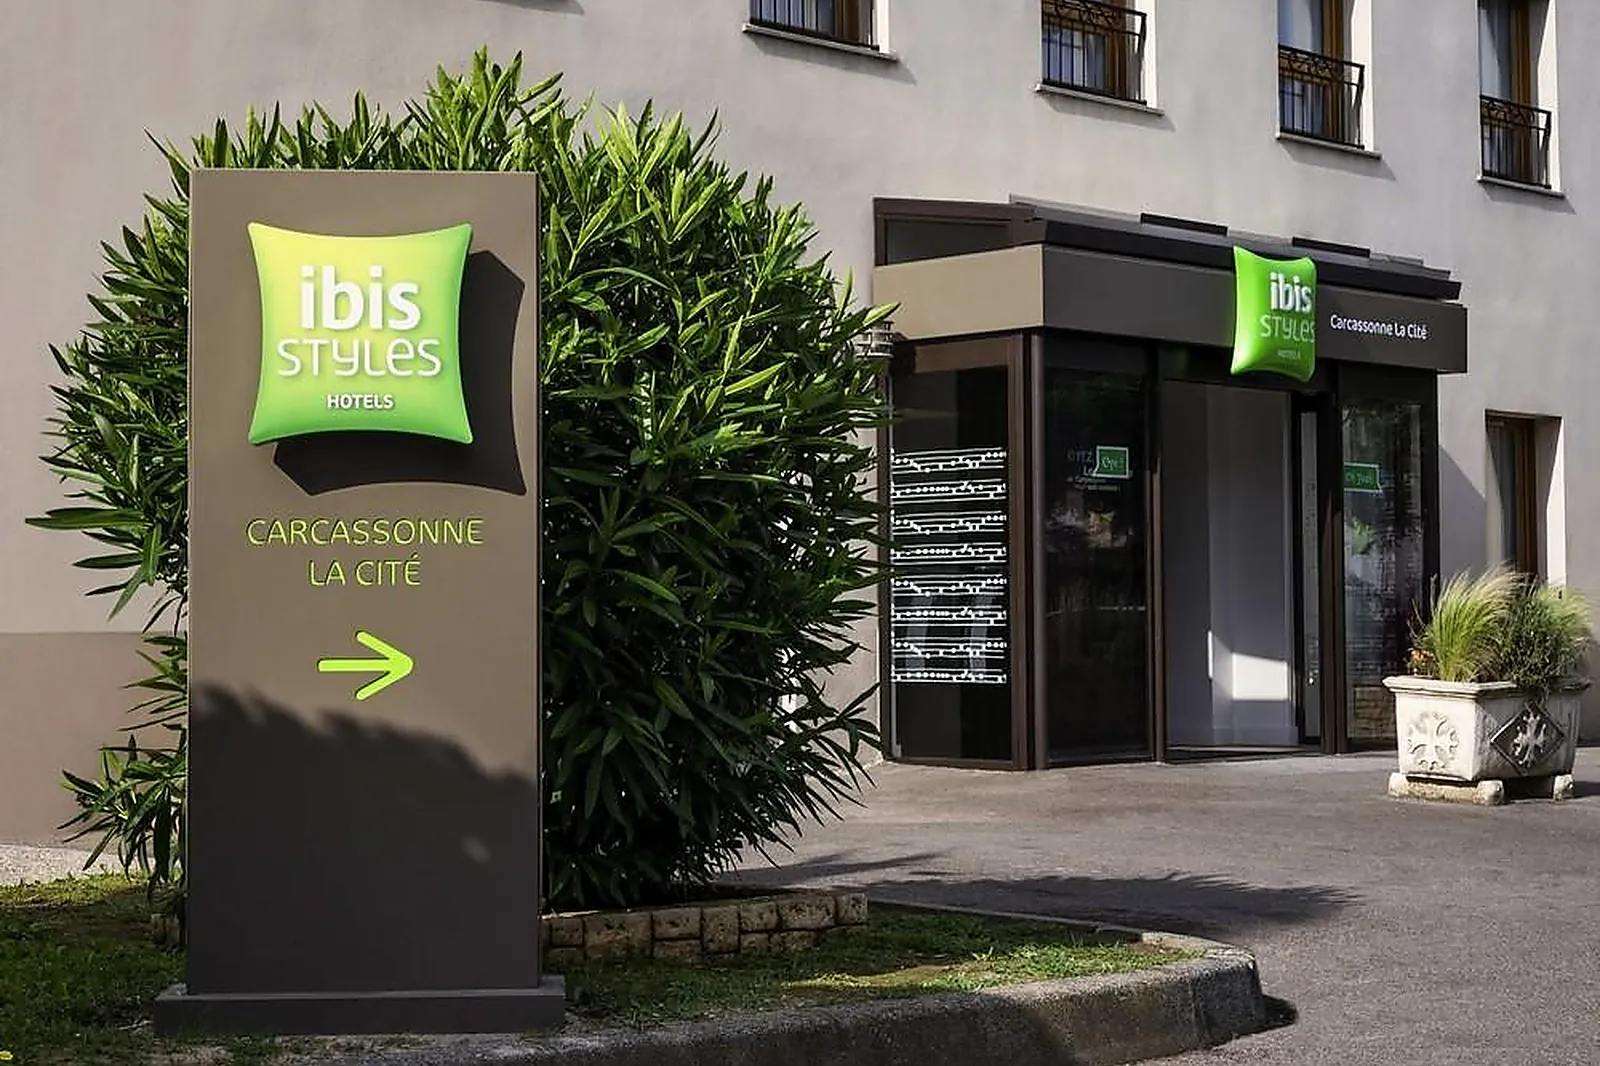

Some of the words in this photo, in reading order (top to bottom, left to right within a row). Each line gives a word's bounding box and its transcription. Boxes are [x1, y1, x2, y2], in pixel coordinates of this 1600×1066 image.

[301, 265, 422, 331] ibis
[1270, 271, 1312, 312] ibis
[1330, 314, 1392, 336] Carcassonne
[1394, 322, 1406, 338] La
[327, 394, 394, 409] HOTELS
[246, 518, 484, 545] CARCASSONNE
[309, 560, 346, 586] LA
[356, 553, 422, 586] CITÉ
